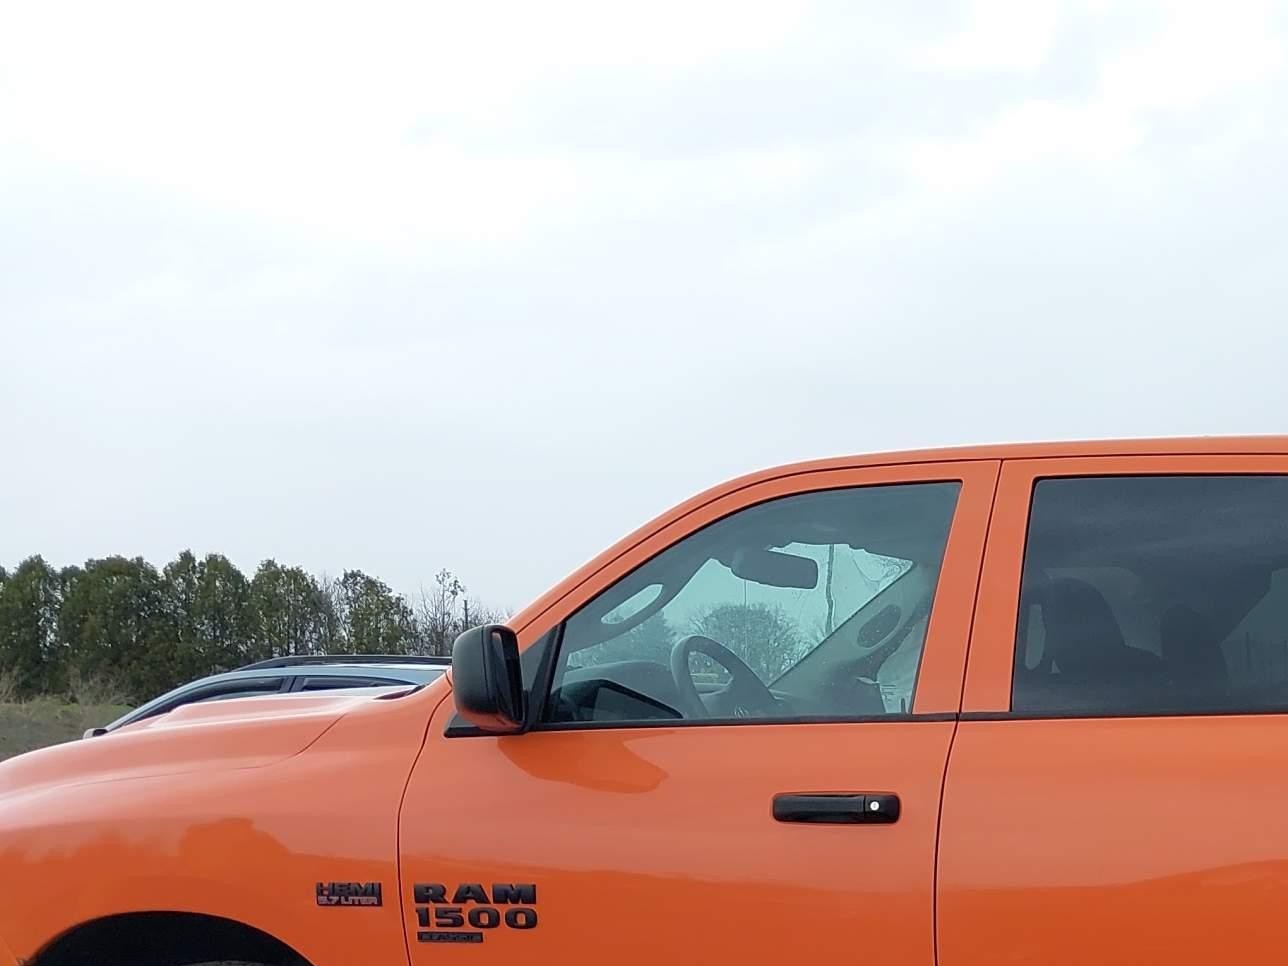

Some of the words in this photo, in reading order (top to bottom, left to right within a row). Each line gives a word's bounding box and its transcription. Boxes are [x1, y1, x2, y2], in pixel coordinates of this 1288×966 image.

[316, 882, 382, 896] HEMI
[414, 883, 537, 905] RAM
[317, 896, 339, 905] 5.7
[341, 896, 378, 905] LITER
[415, 907, 538, 929] 1500
